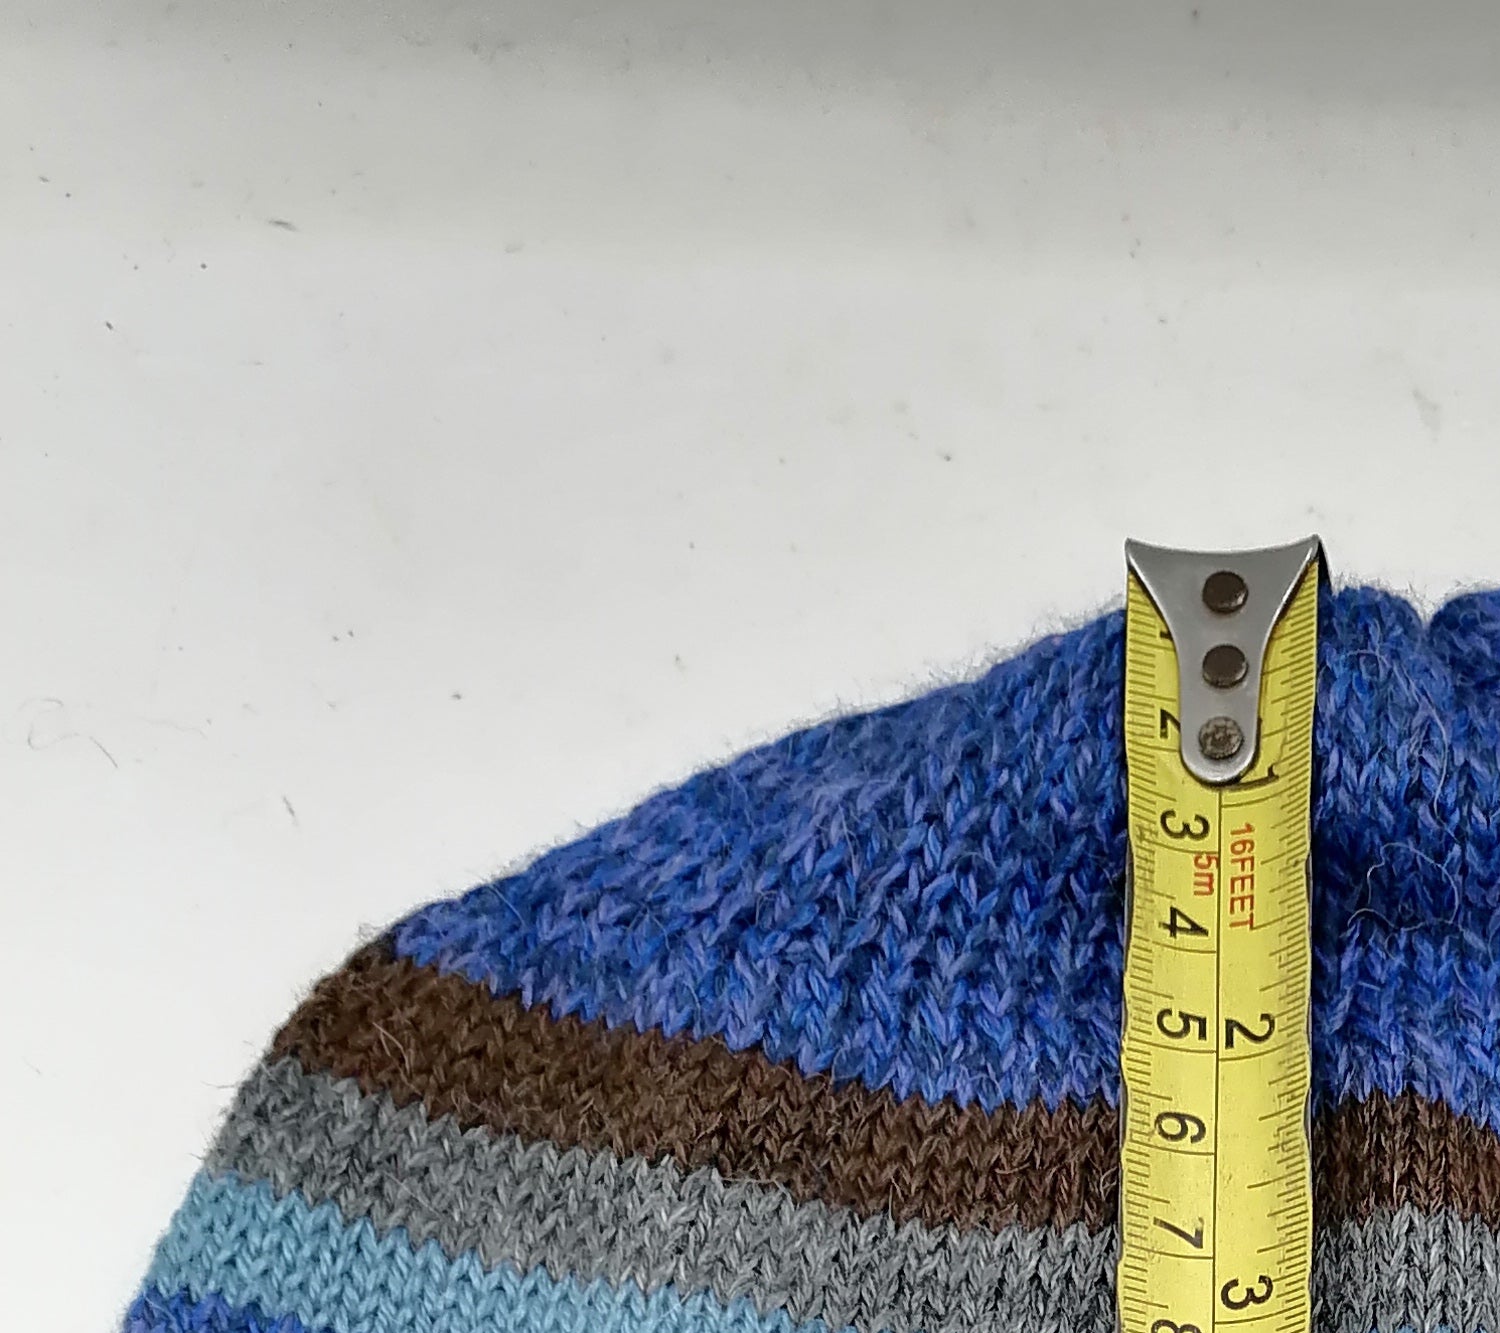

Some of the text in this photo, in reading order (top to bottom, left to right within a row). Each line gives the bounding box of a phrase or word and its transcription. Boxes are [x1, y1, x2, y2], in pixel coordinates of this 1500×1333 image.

[1160, 810, 1210, 841] 3
[1193, 852, 1219, 896] 5m
[1229, 823, 1255, 931] 16FEET
[1159, 906, 1209, 938] 4
[1156, 1008, 1207, 1041] 5
[1225, 1013, 1275, 1049] 2
[1155, 1111, 1206, 1144] 6
[1153, 1217, 1204, 1249] 7
[1221, 1275, 1274, 1310] 3
